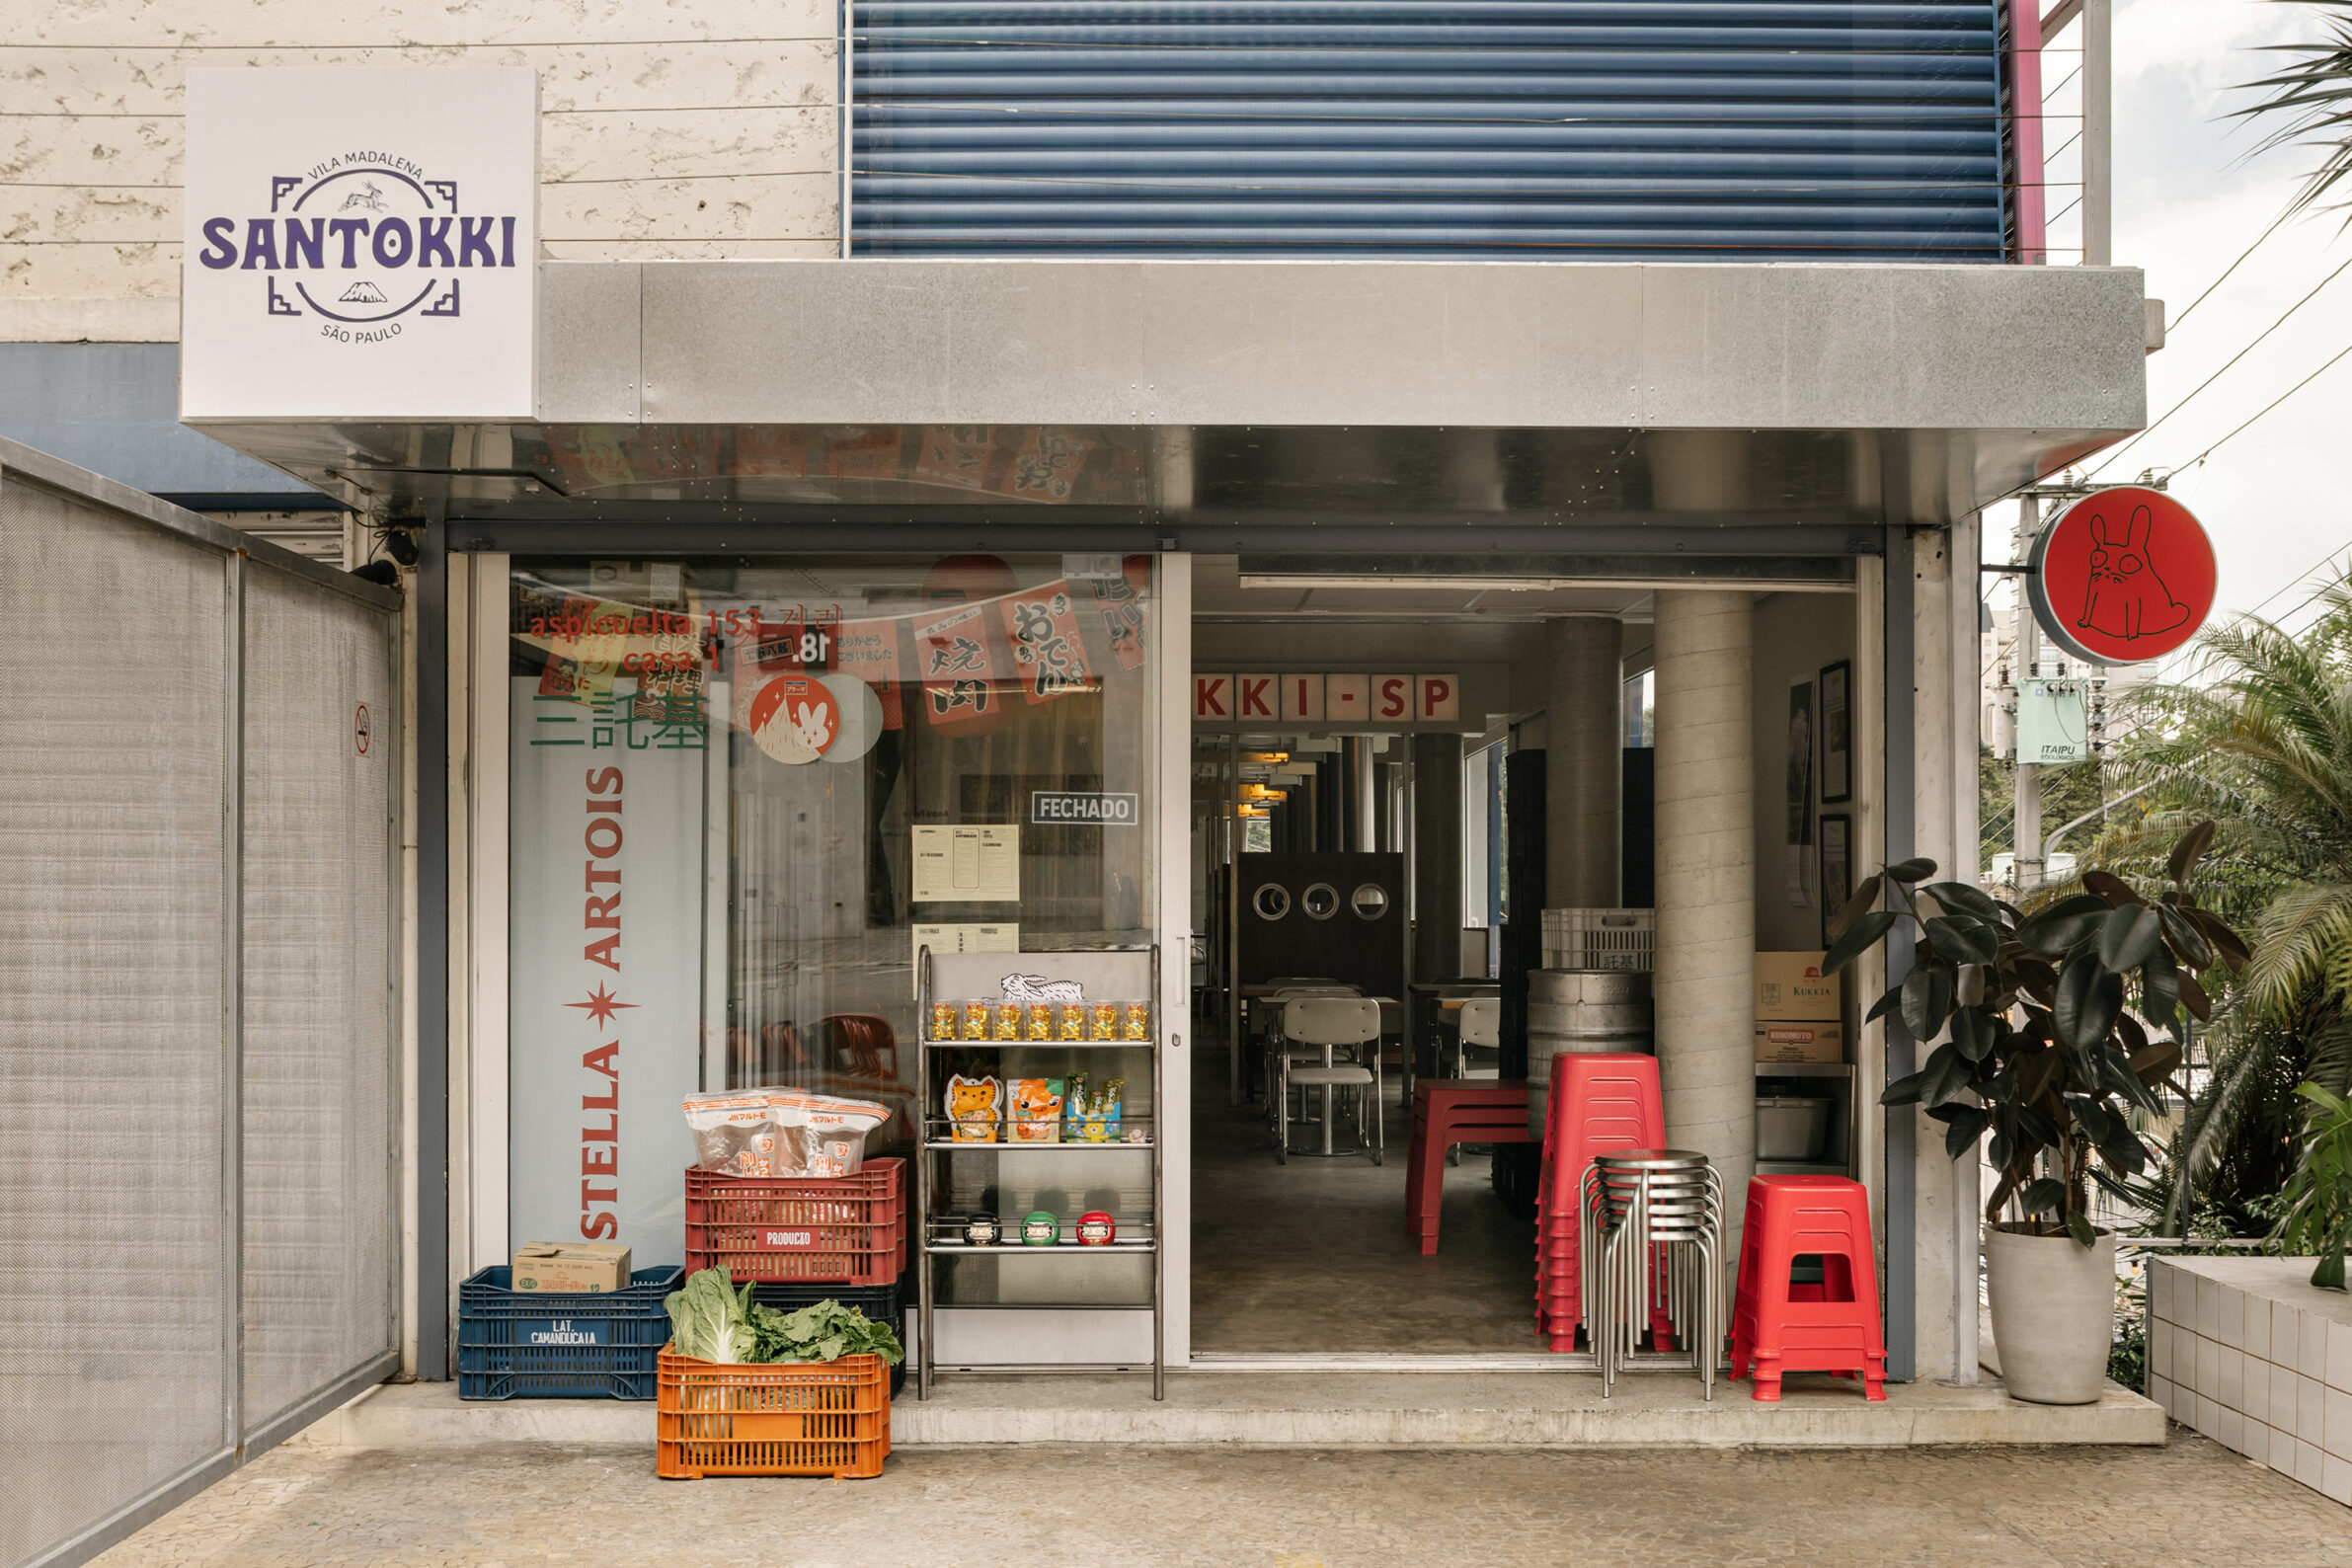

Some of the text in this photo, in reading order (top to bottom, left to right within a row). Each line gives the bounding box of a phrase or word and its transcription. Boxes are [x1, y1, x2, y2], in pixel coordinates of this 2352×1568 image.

[307, 150, 424, 181] VILA MADALENA
[199, 215, 516, 270] SANTOKKI
[321, 322, 402, 344] SÃO PAULO
[529, 607, 691, 643] aspicuelta
[706, 608, 762, 635] 153
[836, 634, 882, 648] ありがとう
[1013, 599, 1069, 697] おでん
[623, 651, 693, 672] casa
[708, 645, 719, 670] 1
[836, 650, 893, 663] ございました
[927, 637, 989, 714] 焼肉
[529, 689, 709, 750] 三託基
[2041, 745, 2076, 755] ITAIPU
[1040, 797, 1130, 820] FECHADO
[584, 764, 624, 974] ARTOIS
[1769, 1031, 1813, 1040] HINOMOTO
[738, 1111, 767, 1122] マルトモ
[581, 1038, 620, 1242] STELLA
[530, 1331, 596, 1344] CAMANDUCAIA
[552, 1319, 575, 1332] LAT.
